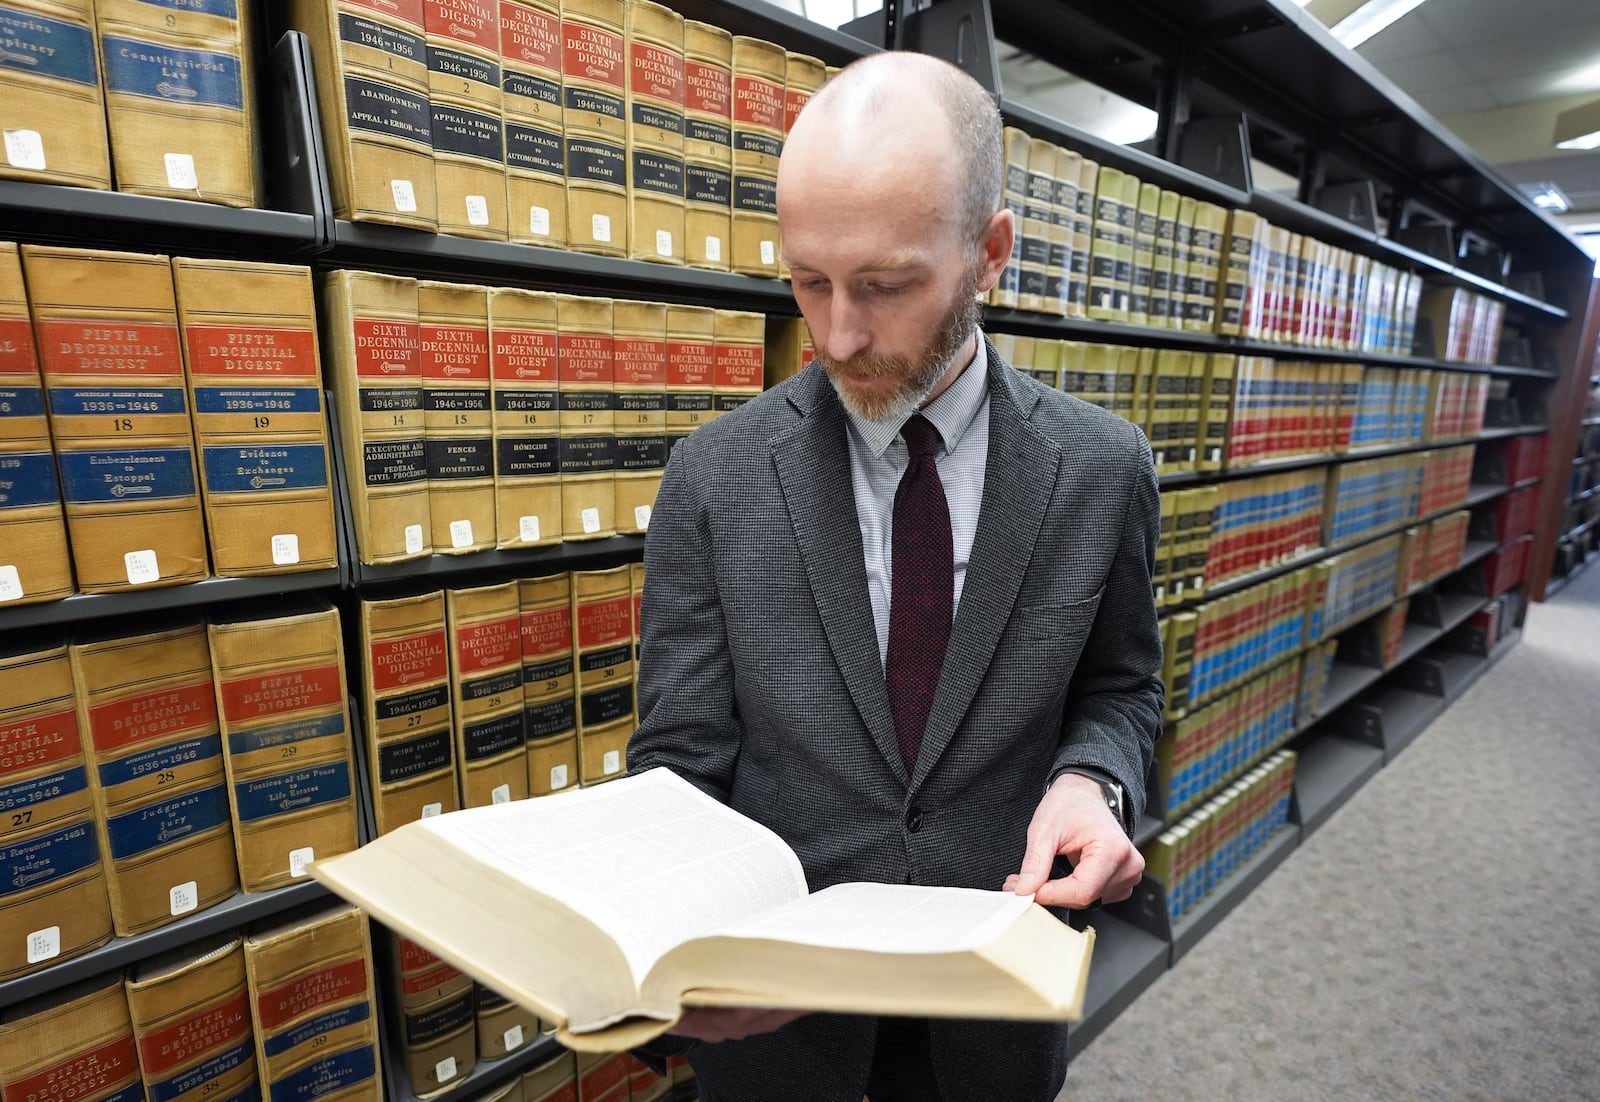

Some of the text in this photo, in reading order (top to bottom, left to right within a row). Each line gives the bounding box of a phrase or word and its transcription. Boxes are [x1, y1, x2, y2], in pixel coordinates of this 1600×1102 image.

[166, 14, 177, 27] 9
[439, 6, 484, 30] DIGEST
[515, 9, 549, 30] SIXTH
[501, 17, 561, 46] DECENNIAL
[580, 29, 612, 47] SIXTH
[360, 31, 413, 56] 1946 1956
[513, 32, 553, 54] DIGEST
[567, 38, 623, 63] DECENNIAL
[119, 49, 226, 73] Constitutional
[578, 51, 615, 71] DIGEST
[646, 49, 674, 66] SIXTH
[162, 66, 190, 80] Law
[439, 60, 489, 81] 1946 1956
[635, 57, 683, 81] DECENNIAL
[698, 67, 725, 82] SIXTH
[644, 70, 677, 88] DIGEST
[464, 82, 470, 93] 2
[513, 82, 556, 102] 1946 1956
[687, 75, 732, 97] DECENNIAL
[748, 81, 774, 97] SIXTH
[360, 88, 421, 111] ABANDONMENT
[696, 87, 727, 103] DIGEST
[737, 89, 783, 109] DECENNIAL
[533, 102, 540, 113] 3
[576, 99, 618, 116] 1946 1956
[746, 100, 776, 116] DIGEST
[351, 111, 383, 125] APPEAL
[390, 118, 413, 131] ERROR
[433, 112, 466, 125] APPEAL
[474, 120, 498, 132] ERROR
[643, 114, 659, 125] 1946
[664, 119, 679, 131] 1956
[477, 130, 490, 140] End
[658, 132, 665, 142] 5
[694, 128, 710, 139] 1946
[514, 132, 559, 149] APPEARANCE
[744, 139, 760, 150] 1946
[570, 144, 611, 157] AUTOMOBILES
[507, 152, 550, 166] AUTOMOBILES
[588, 165, 614, 177] BIGAMY
[643, 178, 678, 190] CONSPIRACY
[82, 328, 139, 342] FIFTH
[372, 324, 407, 337] SIXTH
[436, 330, 474, 342] SIXTH
[228, 333, 275, 345] FIFTH
[358, 335, 419, 349] DECENNIAL
[510, 334, 544, 346] SIXTH
[570, 338, 602, 349] SIXTH
[60, 341, 164, 357] DECENNIAL
[209, 346, 295, 359] DECENNIAL
[422, 341, 487, 353] DECENNIAL
[497, 344, 556, 357] DECENNIAL
[559, 348, 612, 359] DECENNIAL
[627, 342, 656, 353] SIXTH
[681, 345, 706, 356] SIXTH
[728, 348, 753, 359] SIXTH
[371, 349, 412, 361] DIGEST
[434, 352, 478, 365] DIGEST
[508, 355, 548, 367] DIGEST
[614, 351, 666, 362] DECENNIAL
[670, 354, 713, 365] DECENNIAL
[80, 357, 148, 370] DIGEST
[225, 359, 283, 371] DIGEST
[569, 358, 606, 369] DIGEST
[624, 361, 660, 371] DIGEST
[678, 363, 708, 374] DIGEST
[717, 357, 762, 368] DECENNIAL
[726, 366, 756, 376] DIGEST
[82, 401, 158, 412] 1936 1946
[226, 400, 290, 409] 1936 1946
[372, 398, 417, 409] 1946 1956
[435, 399, 483, 409] 1946 1956
[507, 400, 551, 409] 1946 1956
[567, 401, 584, 409] 1946
[114, 419, 133, 431] 18
[253, 417, 269, 428] 19
[393, 415, 404, 425] 14
[454, 414, 467, 425] 15
[524, 414, 536, 424] 16
[583, 414, 594, 424] 17
[637, 414, 648, 423] 18
[239, 449, 288, 459] Evidence
[366, 444, 408, 455] EXECUTORS
[447, 446, 476, 454] FENCES
[513, 443, 548, 452] HOMICIDE
[89, 455, 166, 467] Embezzlement
[366, 451, 424, 461] ADMINISTRATORS
[237, 465, 294, 475] Exchanges
[384, 464, 415, 474] FEDERAL
[439, 465, 485, 474] HOMESTEAD
[510, 461, 551, 470] INJUNCTION
[104, 472, 156, 485] Estoppel
[368, 473, 390, 481] CIVIL
[533, 611, 562, 624] SIXTH
[473, 624, 507, 639] SIXTH
[521, 619, 572, 637] DECENNIAL
[462, 630, 519, 650] DECENNIAL
[531, 629, 566, 644] DIGEST
[391, 638, 428, 653] SIXTH
[473, 641, 512, 657] DIGEST
[377, 645, 442, 667] DECENNIAL
[389, 656, 433, 675] DIGEST
[243, 683, 323, 704] DECENNIAL
[133, 693, 179, 713] FIFTH
[258, 696, 311, 712] DIGEST
[389, 697, 437, 716] 1946 1956
[488, 697, 501, 707] 28
[114, 700, 201, 731] DECENNIAL
[407, 715, 422, 728] 27
[130, 715, 187, 739] DIGEST
[280, 746, 297, 758] 29
[131, 750, 197, 776] 1936 1946
[156, 770, 175, 785] 28
[248, 777, 283, 793] Justices
[296, 771, 311, 781] the
[313, 766, 336, 777] Peace
[28, 785, 60, 801] 1946
[269, 790, 287, 801] Life
[141, 796, 200, 821] Judgment
[11, 810, 33, 827] 27
[160, 815, 187, 831] Jury
[10, 841, 52, 858] Revenue
[12, 858, 51, 875] Judges
[279, 977, 351, 1010] DECENNIAL
[179, 1009, 224, 1036] FIFTH
[161, 1013, 242, 1055] DECENNIAL
[177, 1029, 231, 1059] DIGEST
[47, 1054, 98, 1084] FIFTH
[26, 1057, 121, 1102] DECENNIAL
[202, 1080, 220, 1096] 38
